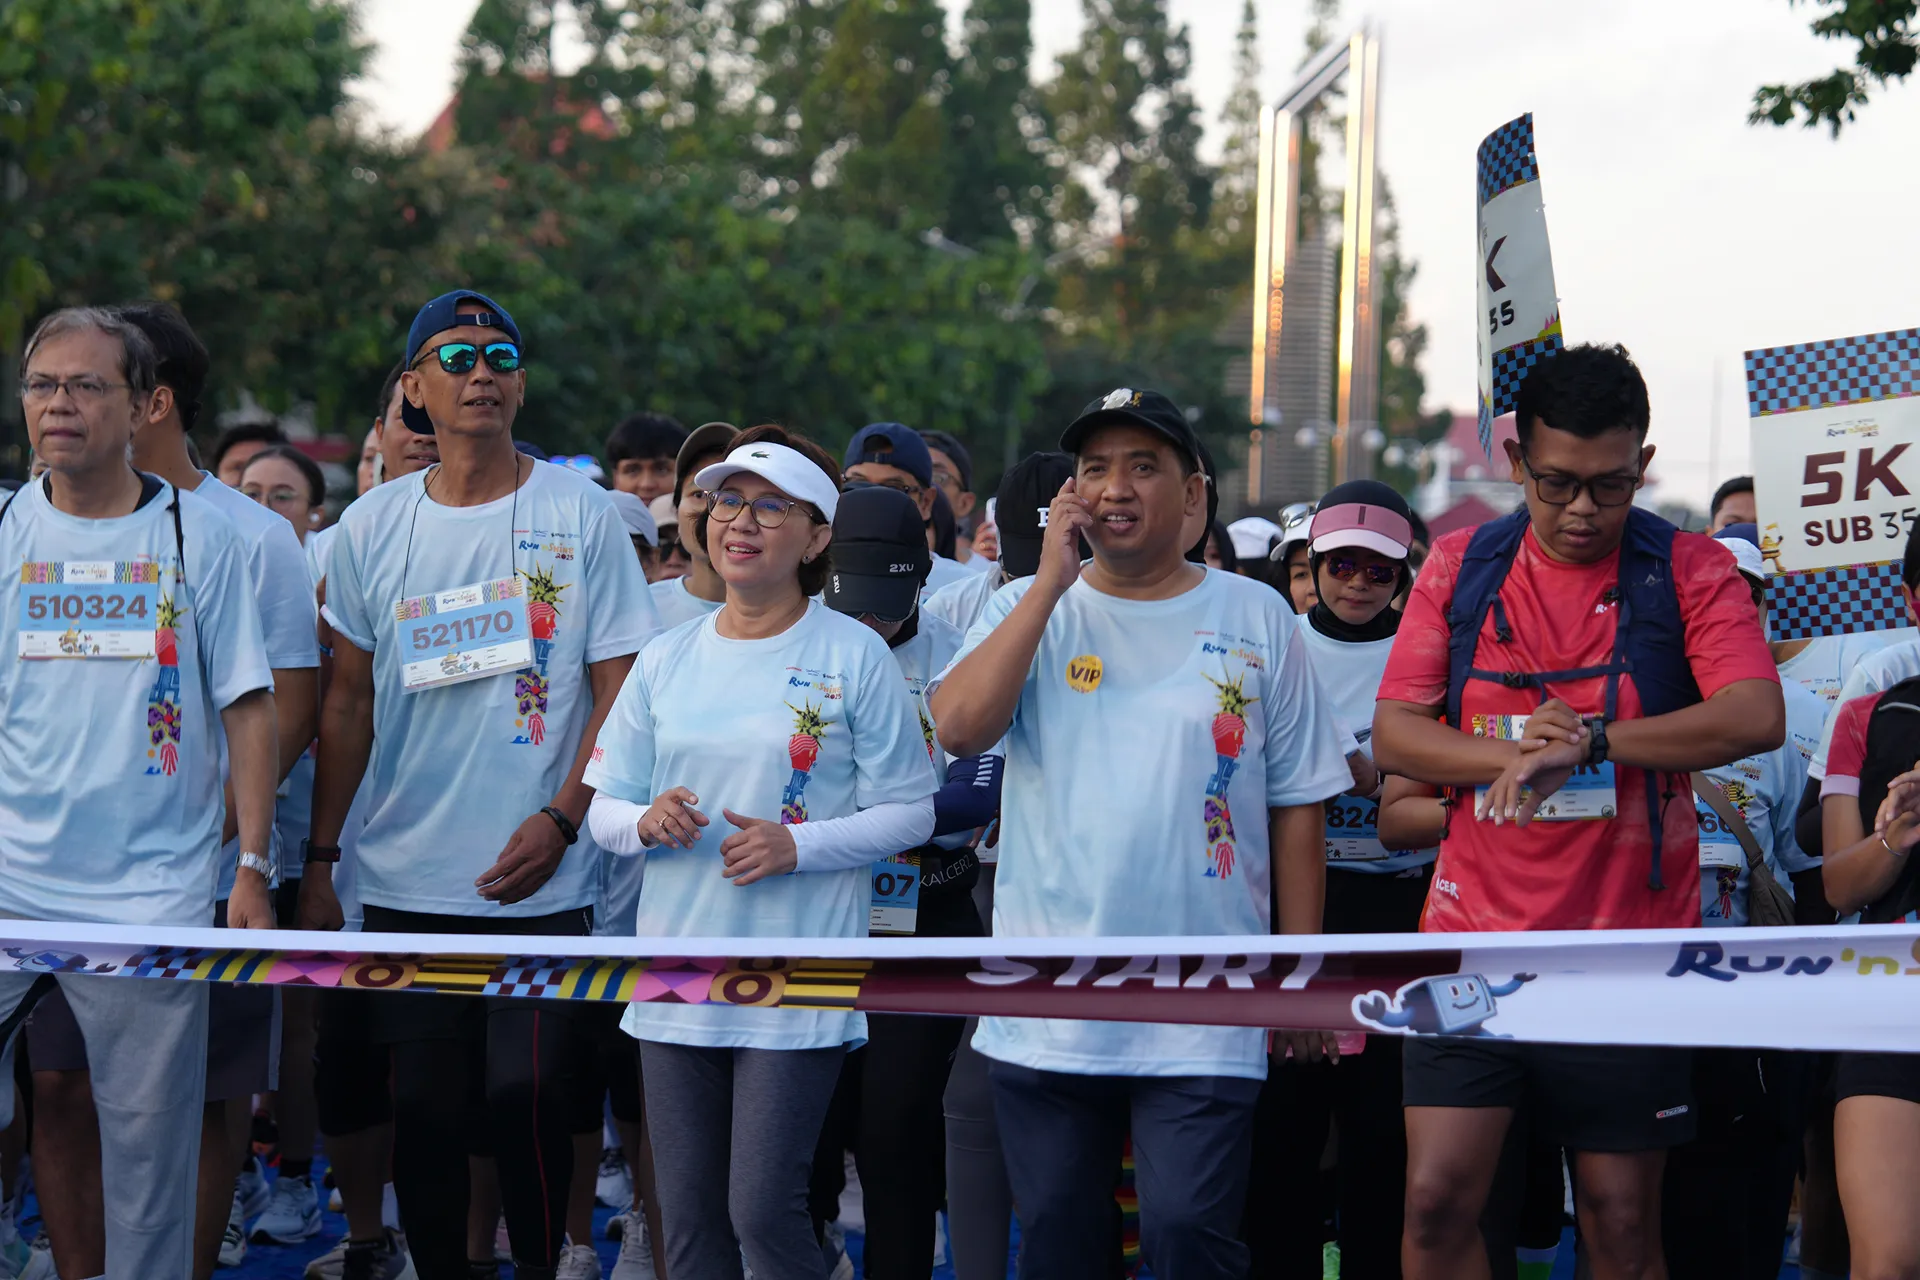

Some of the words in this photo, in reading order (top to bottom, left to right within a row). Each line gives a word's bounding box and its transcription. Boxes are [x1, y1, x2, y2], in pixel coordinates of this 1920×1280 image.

[1800, 442, 1913, 508] 5K
[1804, 515, 1873, 547] SUB
[889, 563, 914, 573] 2XU
[28, 595, 148, 620] 510324
[412, 610, 514, 650] 521170
[1071, 663, 1101, 684] VIP
[872, 872, 915, 897] 07
[966, 952, 1324, 990] START
